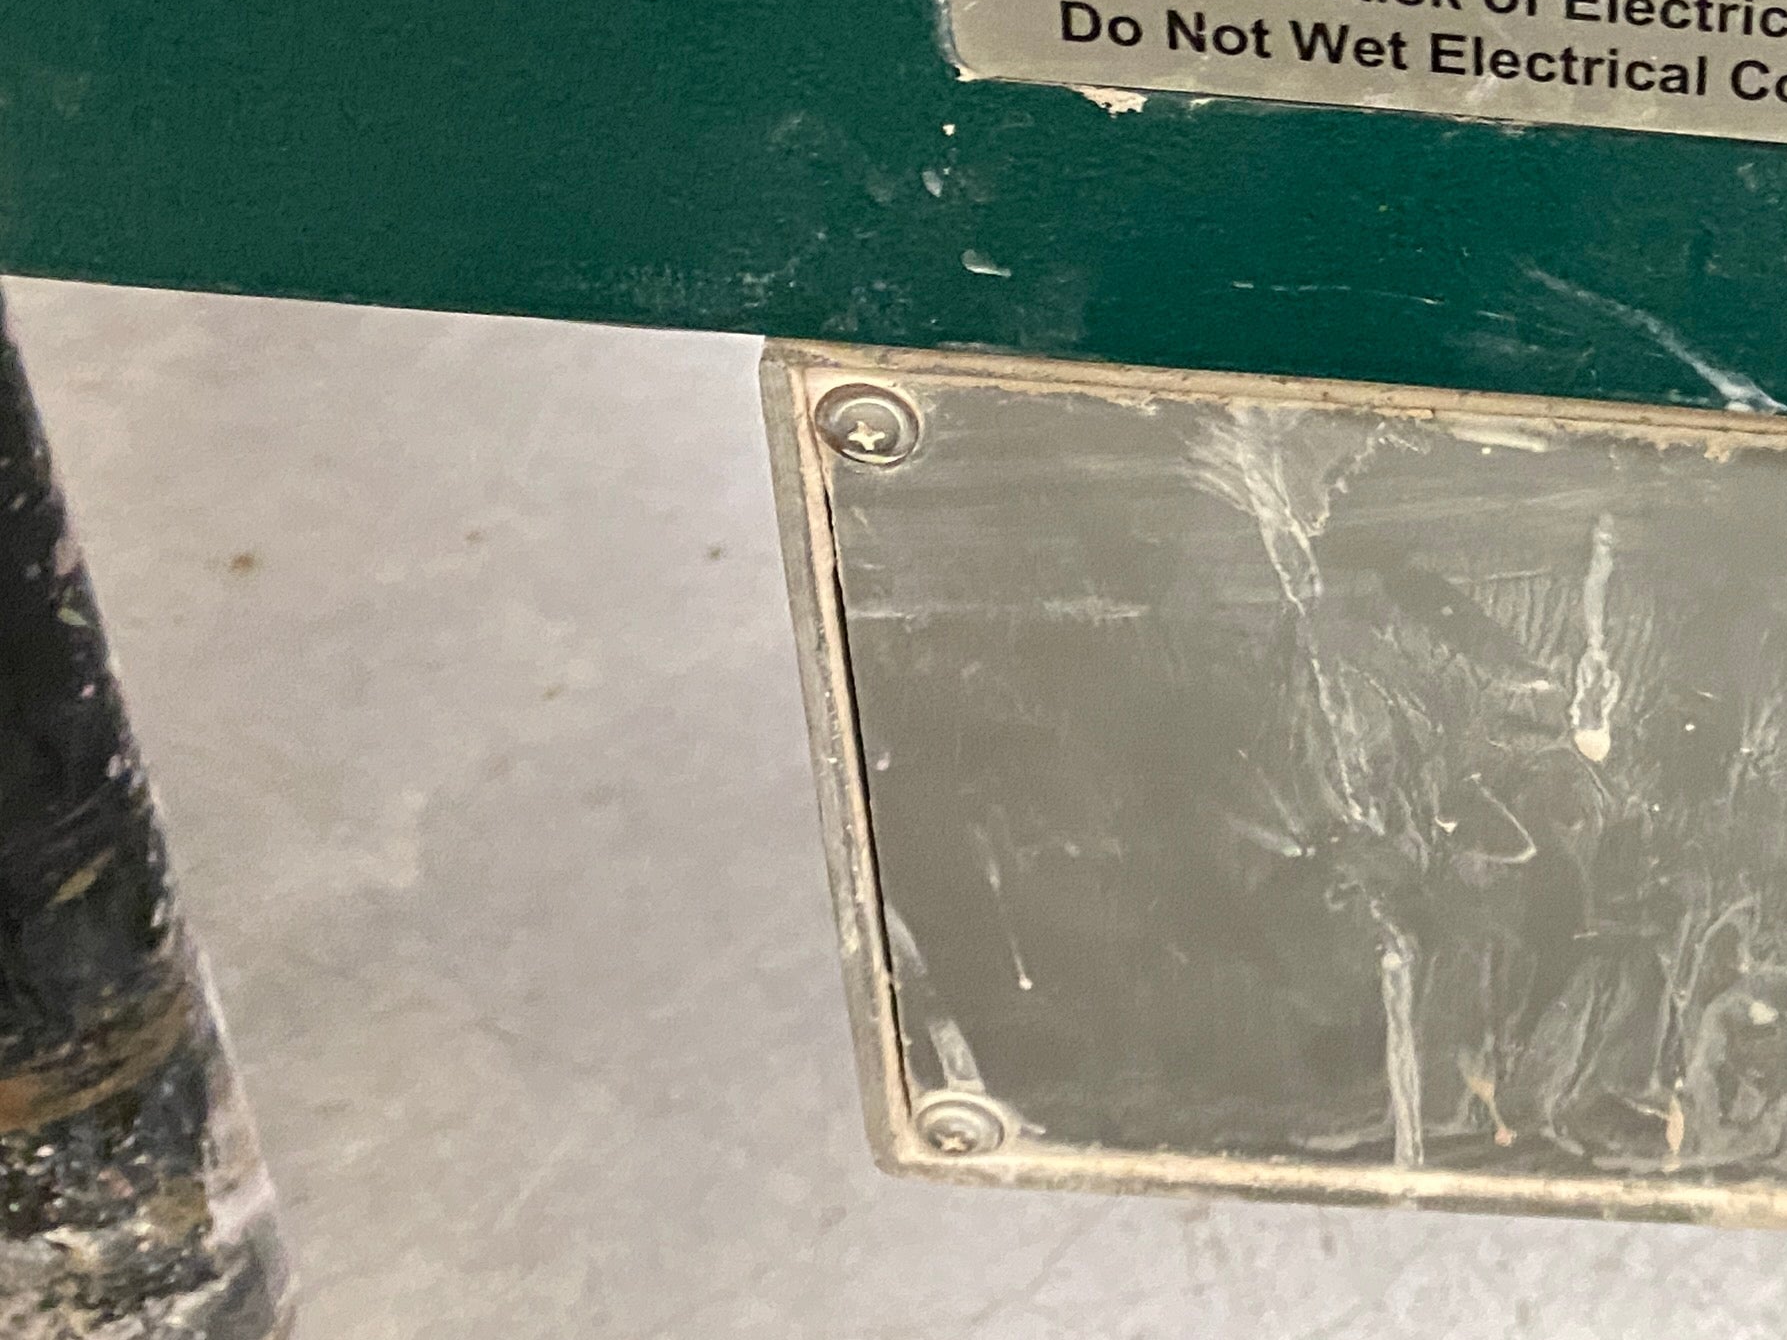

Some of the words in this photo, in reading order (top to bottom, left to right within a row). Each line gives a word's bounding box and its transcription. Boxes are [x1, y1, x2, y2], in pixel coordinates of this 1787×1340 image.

[1059, 0, 1144, 48] Do
[1165, 9, 1272, 60] Not
[1288, 20, 1409, 72] Wet
[1429, 32, 1708, 97] Electrical
